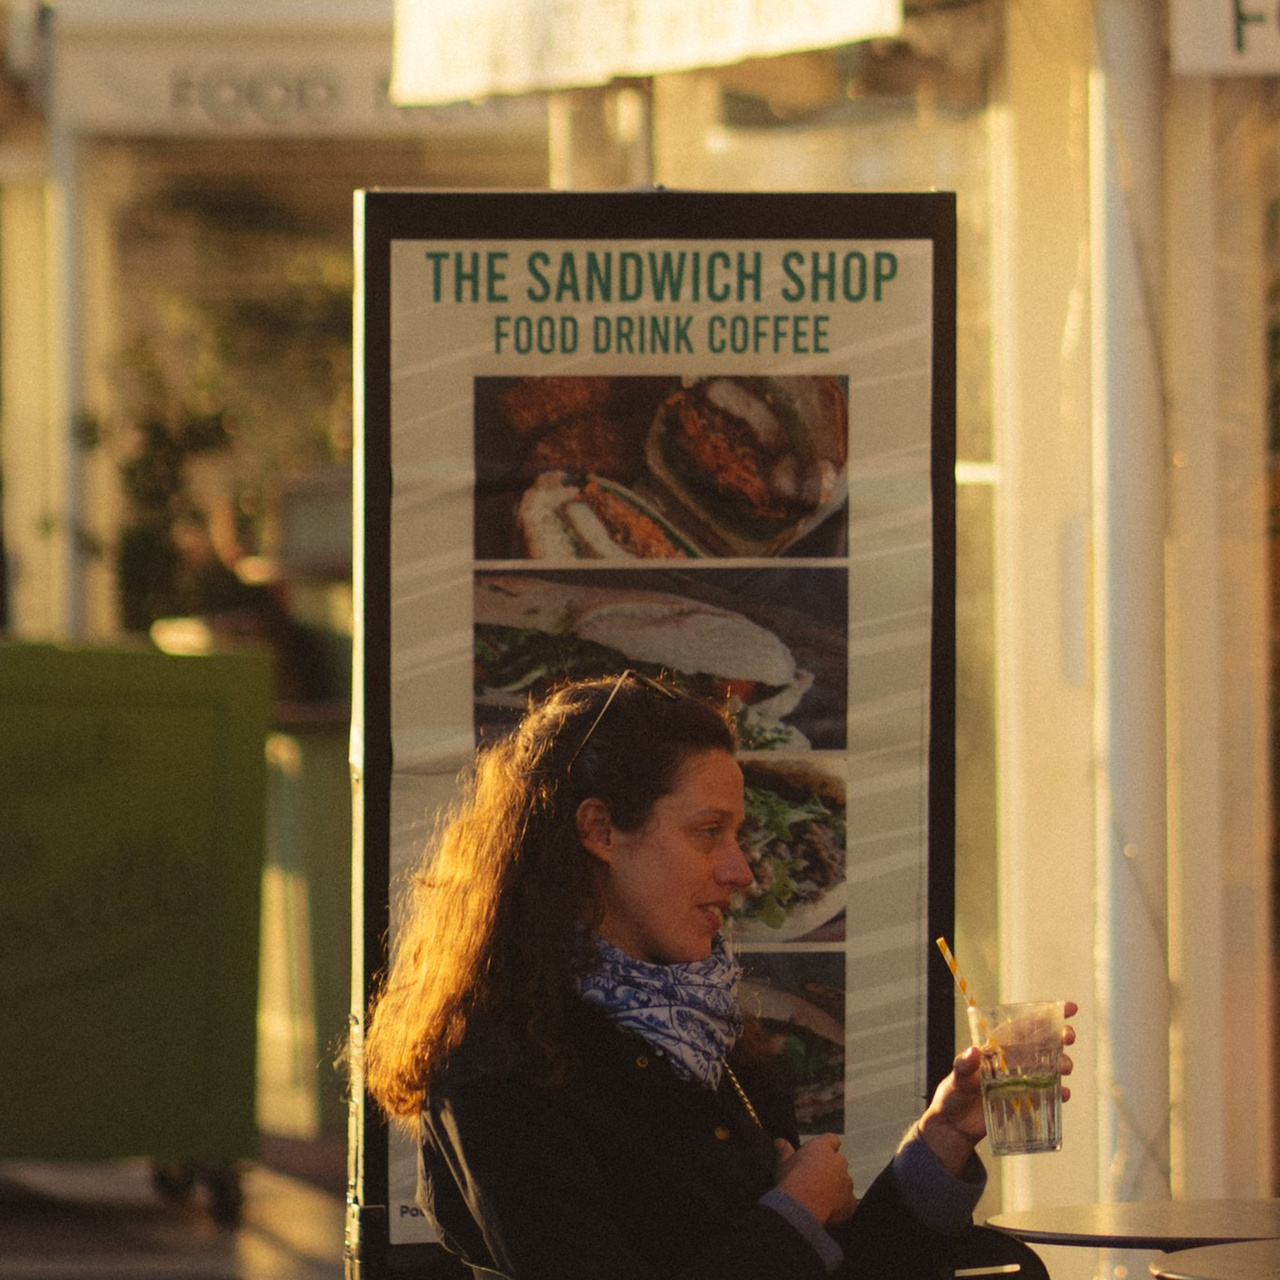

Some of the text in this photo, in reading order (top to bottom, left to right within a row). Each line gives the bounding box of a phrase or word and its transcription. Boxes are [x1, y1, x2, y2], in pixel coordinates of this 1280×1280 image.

[425, 250, 898, 303] THE SANDWICH SHOP
[494, 314, 830, 355] FOOD DRINK COFFEE
